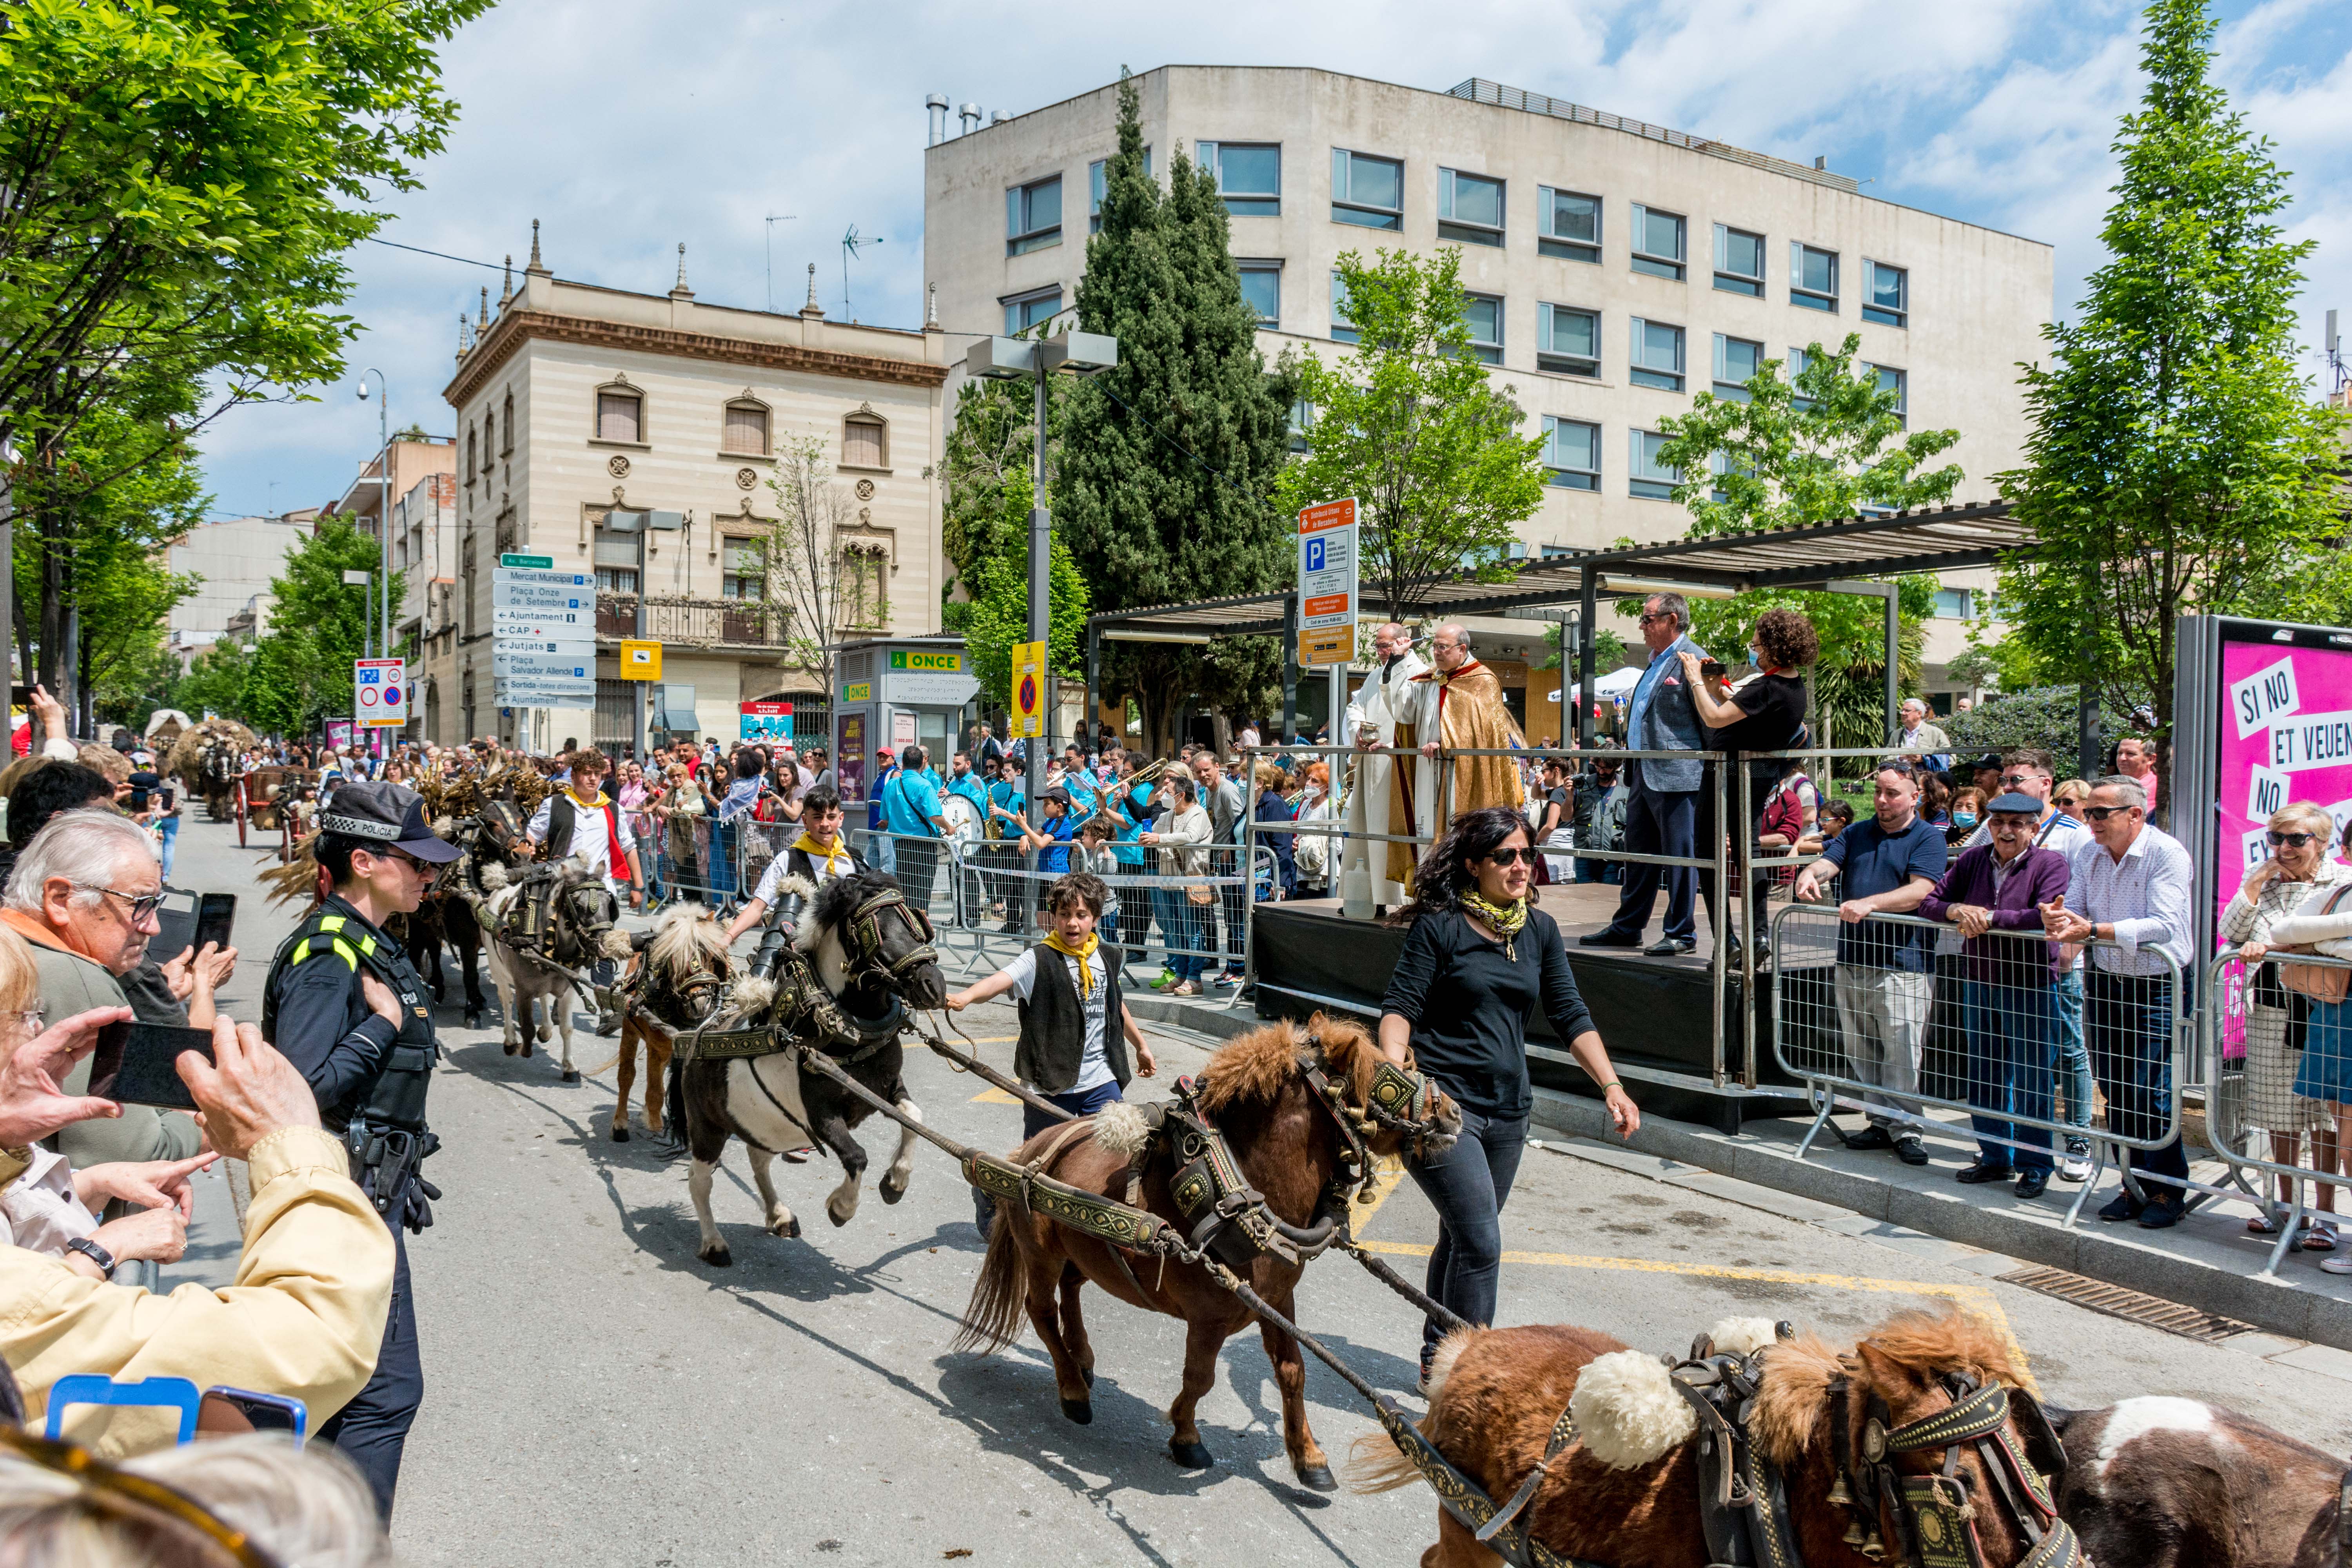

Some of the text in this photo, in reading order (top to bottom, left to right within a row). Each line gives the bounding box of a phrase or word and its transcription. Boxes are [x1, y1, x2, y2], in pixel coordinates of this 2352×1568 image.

[1311, 510, 1328, 519] Distribució
[1318, 517, 1338, 528] Mercaderies
[1311, 543, 1321, 568] P
[511, 572, 537, 581] Mercat
[539, 573, 572, 584] Municipal
[511, 587, 534, 596] Plaça
[526, 598, 566, 606] Setembre
[509, 612, 563, 621] Ajuntament
[509, 642, 544, 651] Jutjats
[511, 656, 534, 666] Plaça
[912, 655, 955, 668] ONCE
[851, 686, 868, 698] ONCE
[2241, 671, 2290, 724] SI NO
[512, 696, 558, 704] Ajuntament
[2276, 729, 2294, 764] ET
[2256, 778, 2280, 816] NO
[362, 824, 392, 837] POLICIA
[1085, 1004, 1104, 1013] WILD
